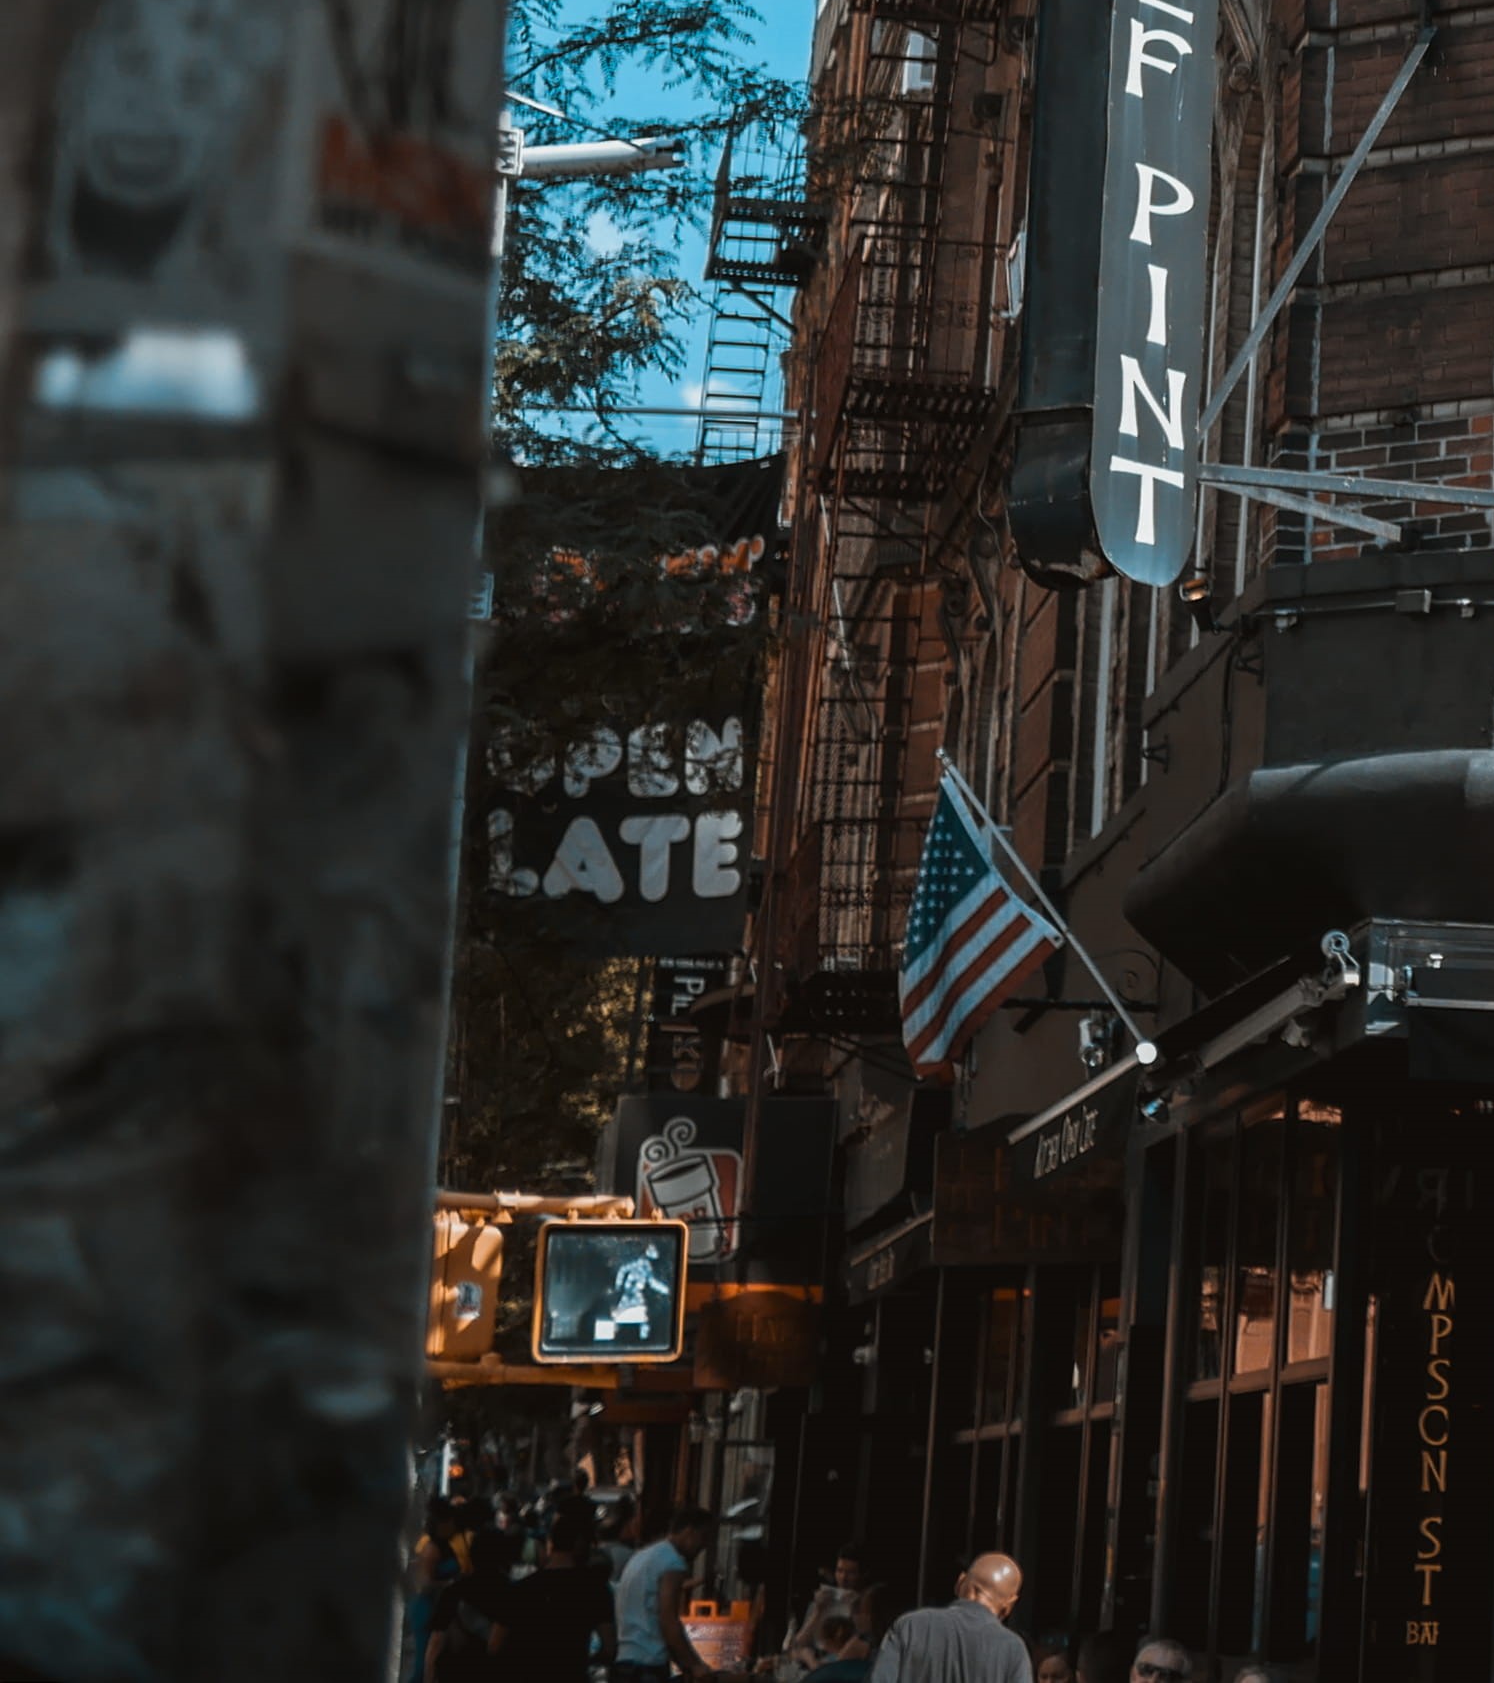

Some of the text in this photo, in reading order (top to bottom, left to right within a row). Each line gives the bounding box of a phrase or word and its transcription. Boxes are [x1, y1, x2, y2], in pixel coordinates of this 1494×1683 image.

[1109, 162, 1195, 546] PINT
[487, 808, 744, 904] LATE
[1415, 1516, 1444, 1606] ST
